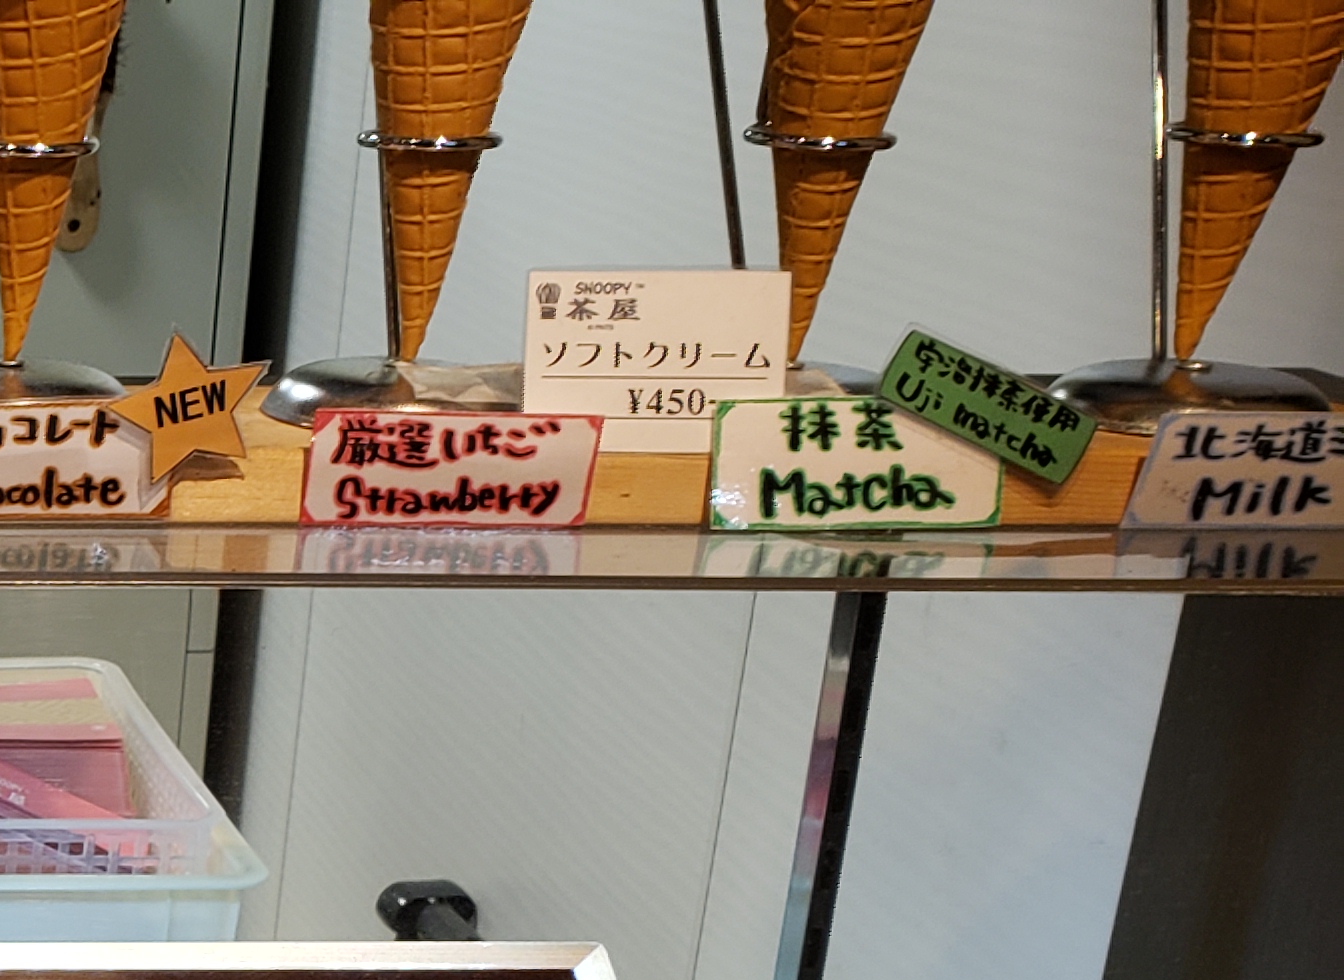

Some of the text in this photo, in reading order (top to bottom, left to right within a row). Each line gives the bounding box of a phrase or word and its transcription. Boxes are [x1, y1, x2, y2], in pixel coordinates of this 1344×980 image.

[565, 298, 641, 321] 茶屋
[574, 281, 632, 295] SNOOPY
[543, 341, 771, 369] ソフトクリーム
[153, 380, 227, 428] NEW
[914, 338, 1081, 432] 宇治抹茶使用
[331, 416, 561, 466] 厳選いちご
[779, 402, 904, 451] 抹茶
[896, 371, 1057, 468] Uji matcha
[336, 475, 560, 519] Strawberry
[760, 463, 956, 519] Matcha
[1190, 475, 1332, 521] Milk
